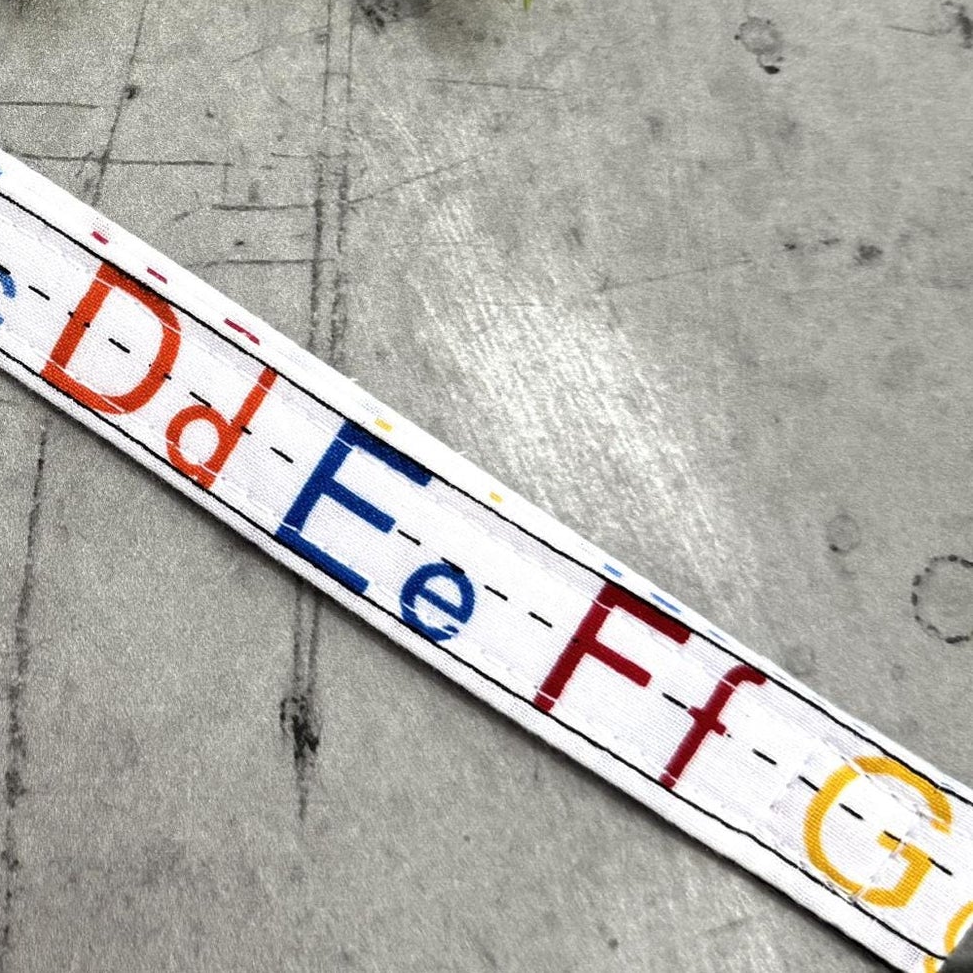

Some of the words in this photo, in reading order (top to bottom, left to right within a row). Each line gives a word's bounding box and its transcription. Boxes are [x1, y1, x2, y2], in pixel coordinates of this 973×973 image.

[39, 261, 278, 491] Dd
[273, 418, 476, 643] Ee
[532, 580, 768, 790] Ff
